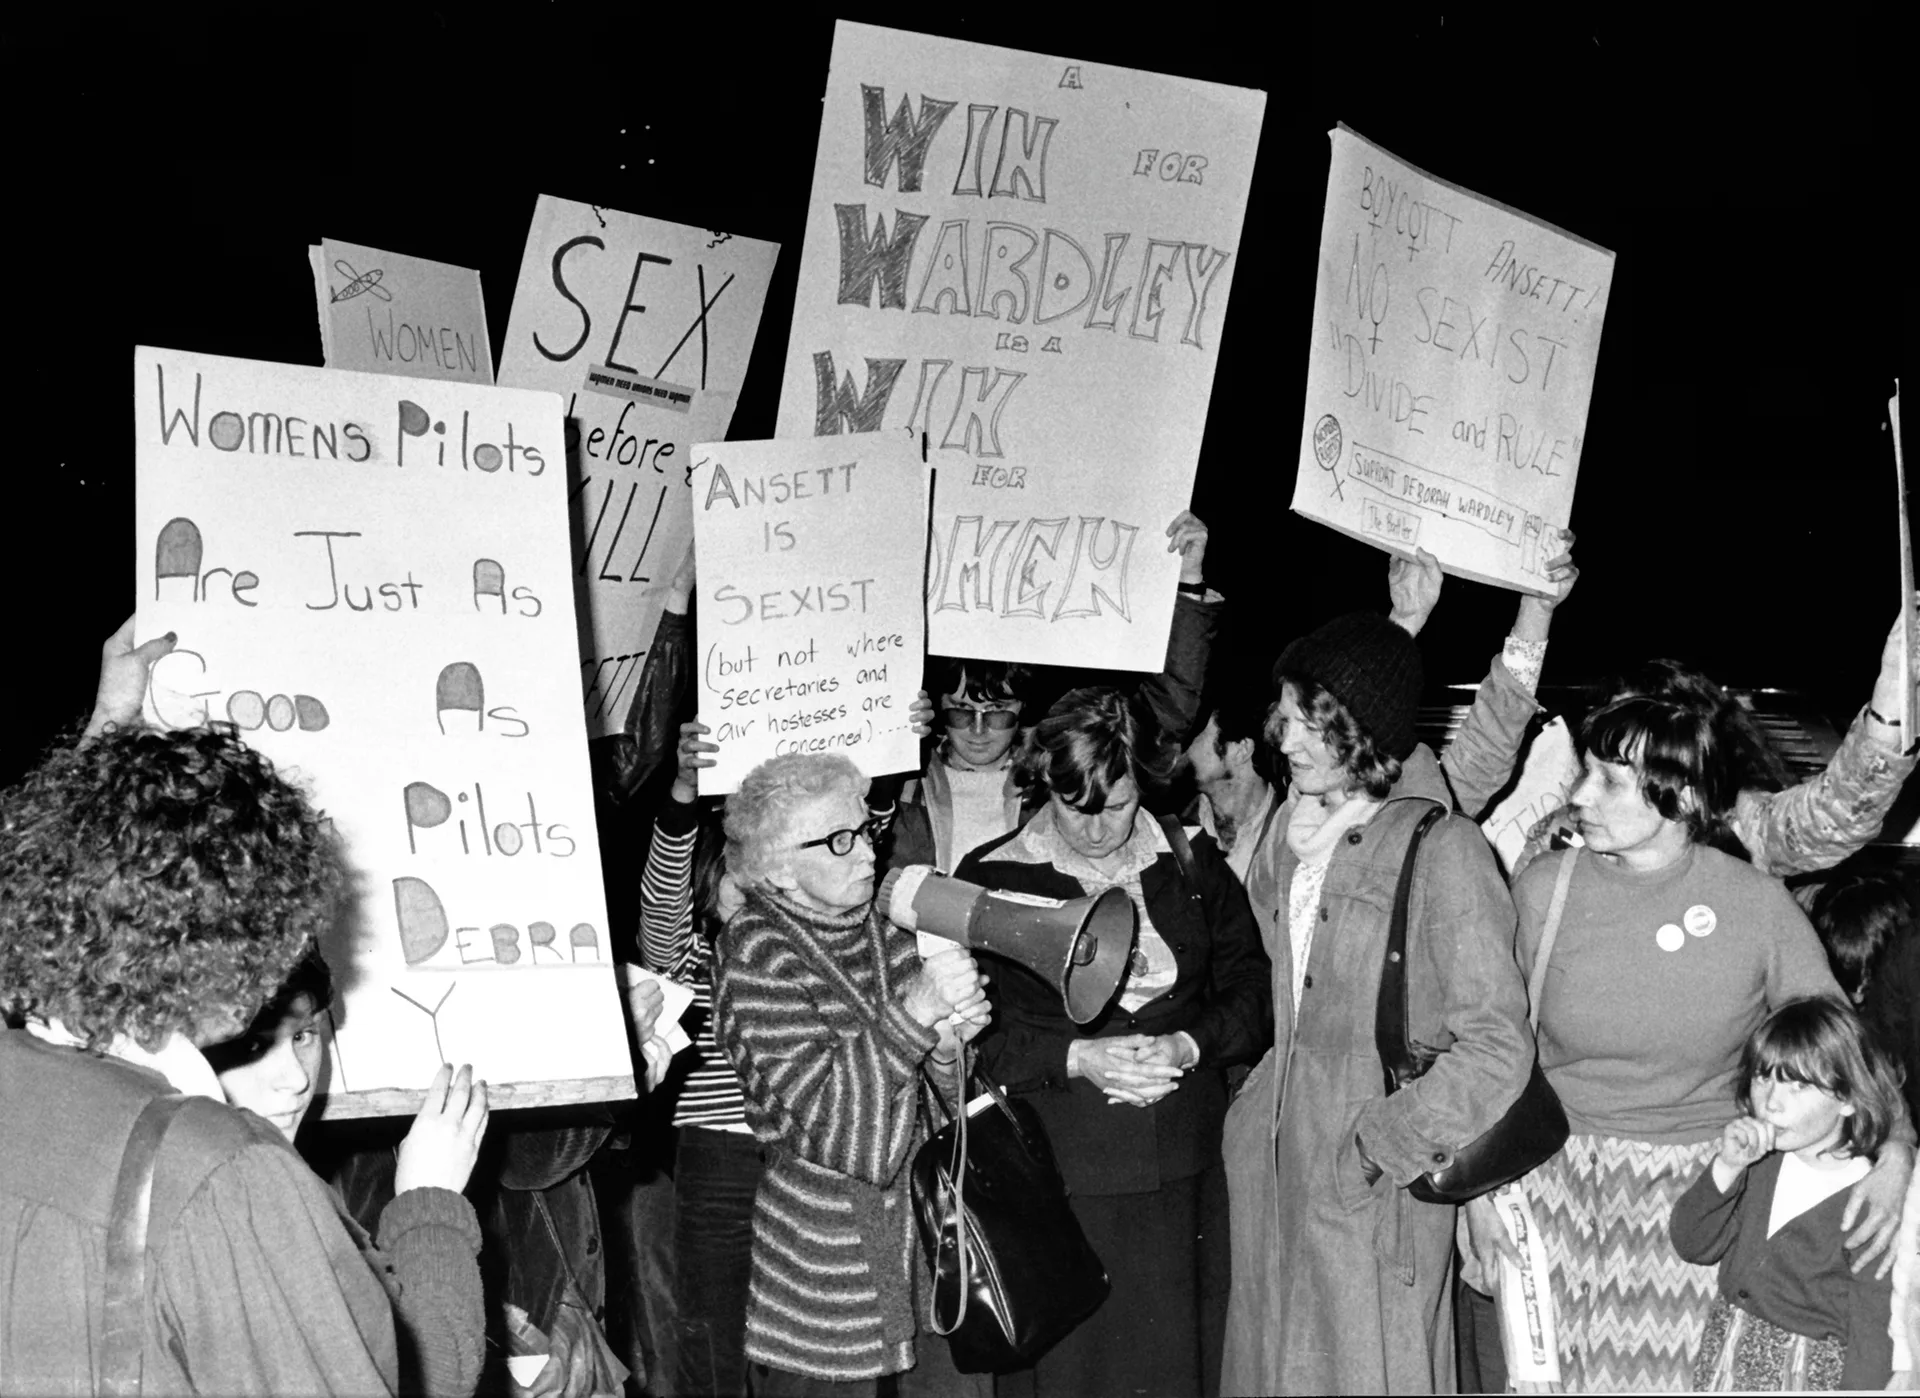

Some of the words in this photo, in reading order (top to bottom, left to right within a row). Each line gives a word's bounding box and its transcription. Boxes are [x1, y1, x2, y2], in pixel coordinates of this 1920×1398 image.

[1059, 65, 1084, 89] A
[860, 82, 1059, 203] WIN
[1133, 149, 1208, 185] FOR
[1360, 166, 1462, 262] BOYCOTT
[834, 202, 1231, 350] WARDLEY
[1346, 232, 1389, 354] NO
[1413, 286, 1567, 391] SEXIST
[367, 306, 477, 373] WOMEN
[533, 235, 735, 391] SEX
[996, 333, 1029, 353] IS
[1041, 336, 1062, 354] A
[397, 399, 545, 477] Pilots
[1452, 416, 1487, 450] and
[1496, 412, 1583, 478] RULE"
[705, 462, 857, 510] ANSETT
[972, 464, 1027, 489] FOR
[1354, 452, 1397, 488] SUPPORT
[1402, 474, 1452, 509] DEBORAH
[1457, 497, 1515, 533] WARDLEY
[155, 516, 259, 608] Are
[293, 531, 423, 612] Just
[472, 557, 542, 618] As
[764, 521, 796, 552] IS
[713, 579, 875, 626] SEXIST
[706, 643, 759, 693] (but
[778, 638, 820, 667] not
[847, 632, 904, 658] where
[720, 674, 840, 710] secretaries
[856, 664, 888, 684] and
[435, 661, 529, 738] As
[716, 719, 755, 743] air
[768, 703, 847, 734] hostesses
[862, 694, 892, 712] are
[403, 781, 576, 858] Pilots
[392, 876, 600, 966] DEBRA
